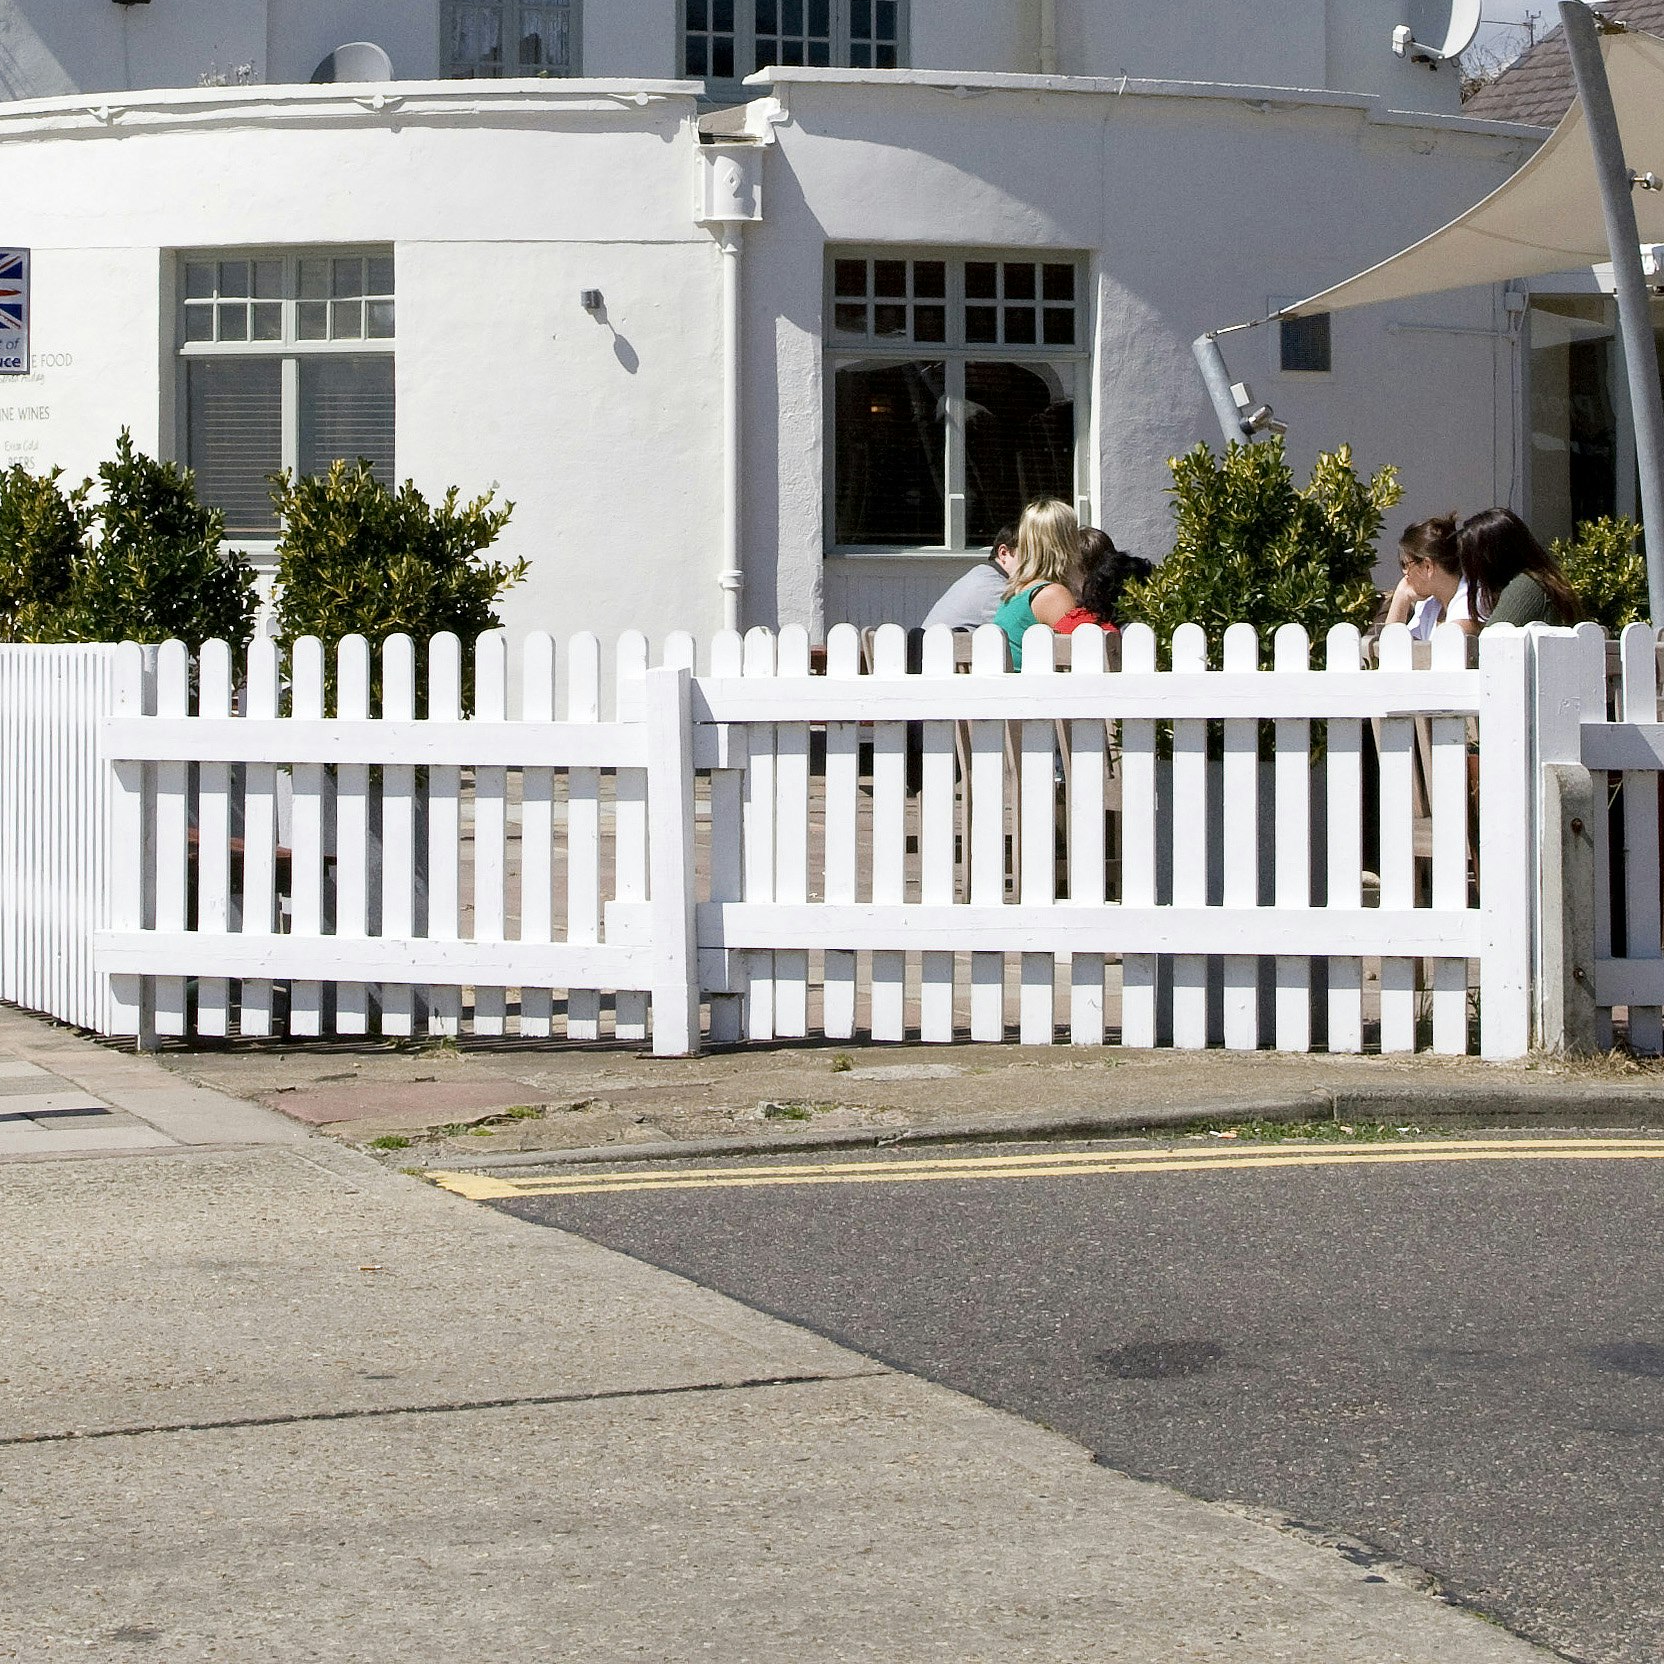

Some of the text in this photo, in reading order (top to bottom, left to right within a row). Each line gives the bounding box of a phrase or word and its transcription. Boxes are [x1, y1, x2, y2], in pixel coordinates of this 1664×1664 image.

[5, 338, 20, 350] of
[41, 353, 72, 367] FOOD
[18, 405, 50, 421] WINES
